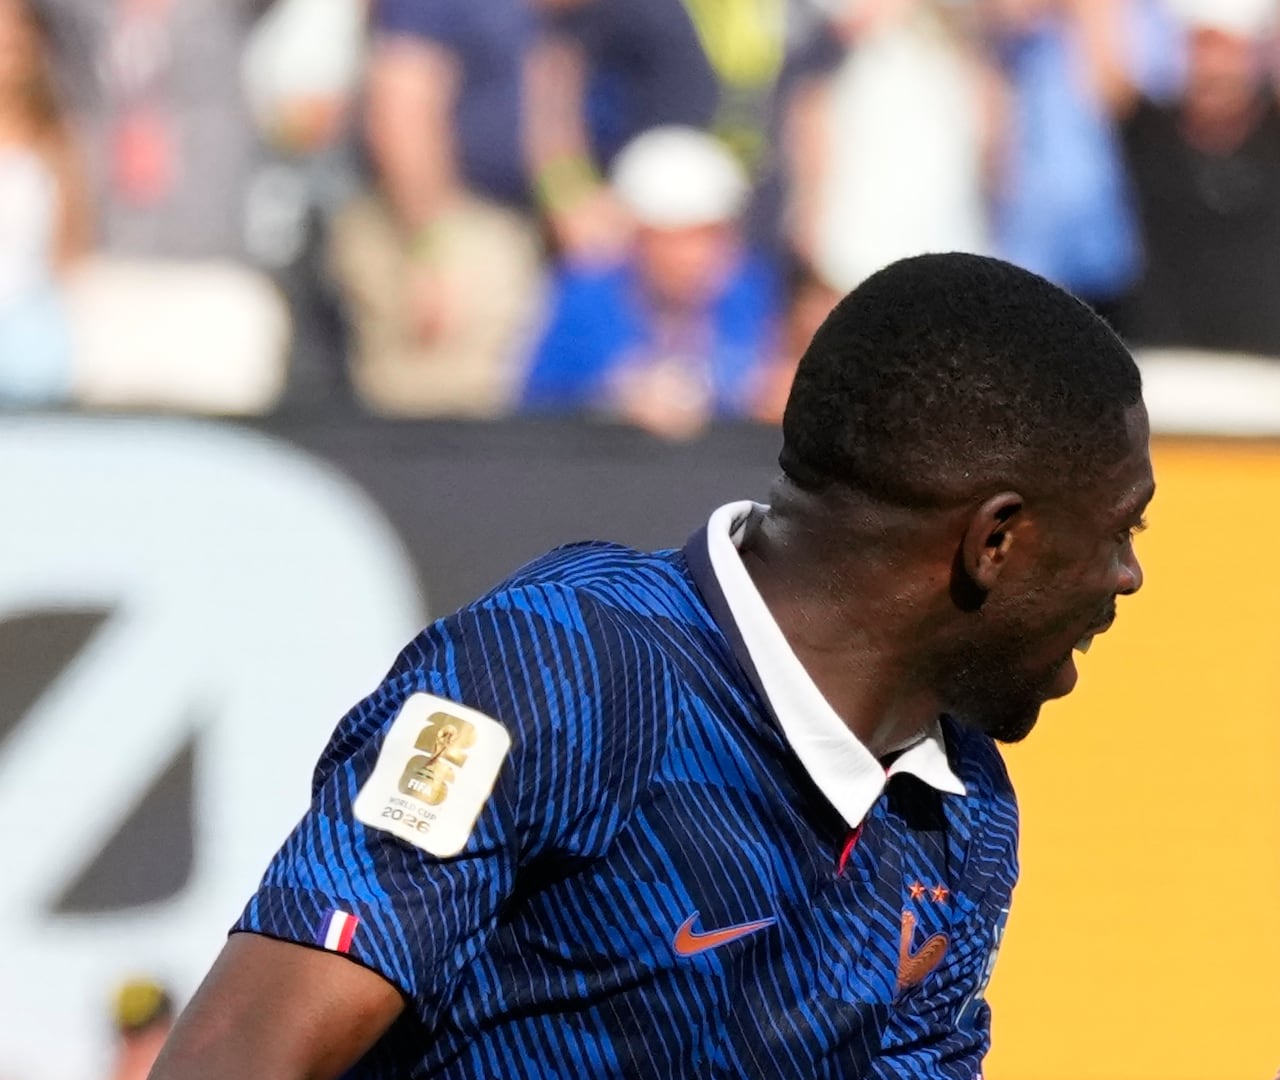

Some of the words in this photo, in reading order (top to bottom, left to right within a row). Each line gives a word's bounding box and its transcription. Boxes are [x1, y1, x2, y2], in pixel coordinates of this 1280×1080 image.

[407, 778, 433, 797] FIFA
[381, 806, 431, 834] 2026
[417, 807, 437, 820] CUP
